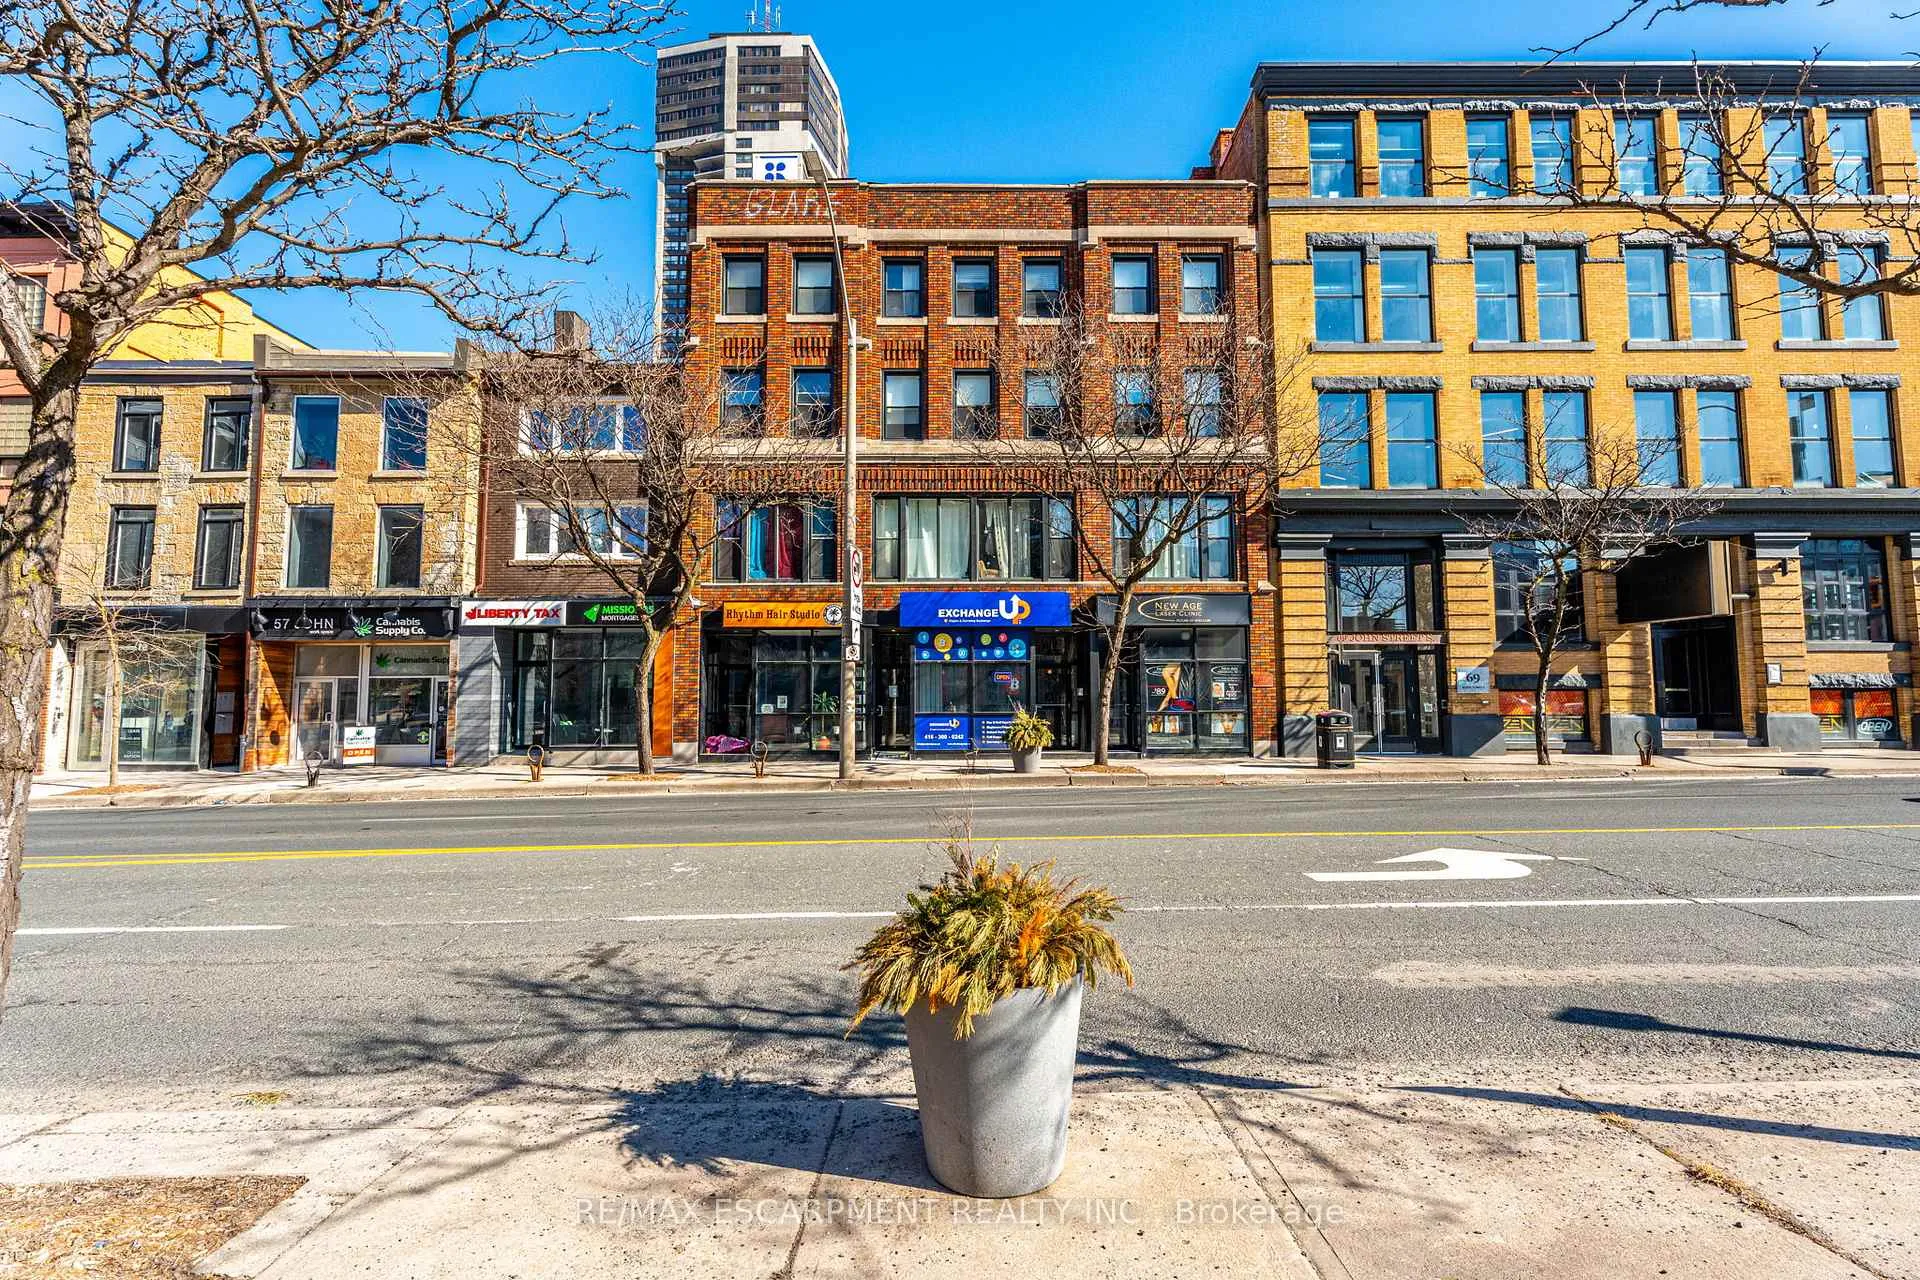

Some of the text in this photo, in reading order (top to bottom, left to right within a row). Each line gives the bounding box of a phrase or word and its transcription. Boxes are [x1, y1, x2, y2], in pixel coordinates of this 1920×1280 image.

[1154, 602, 1203, 610] NEW AGE
[477, 608, 561, 619] LIBERTY TAX
[726, 609, 820, 622] Rhythm Hair Studio
[938, 608, 999, 618] EXCHANGE
[273, 618, 290, 630] 57
[375, 626, 426, 637] Supply Co.
[1466, 672, 1481, 683] 69
[1861, 721, 1889, 732] OPEN
